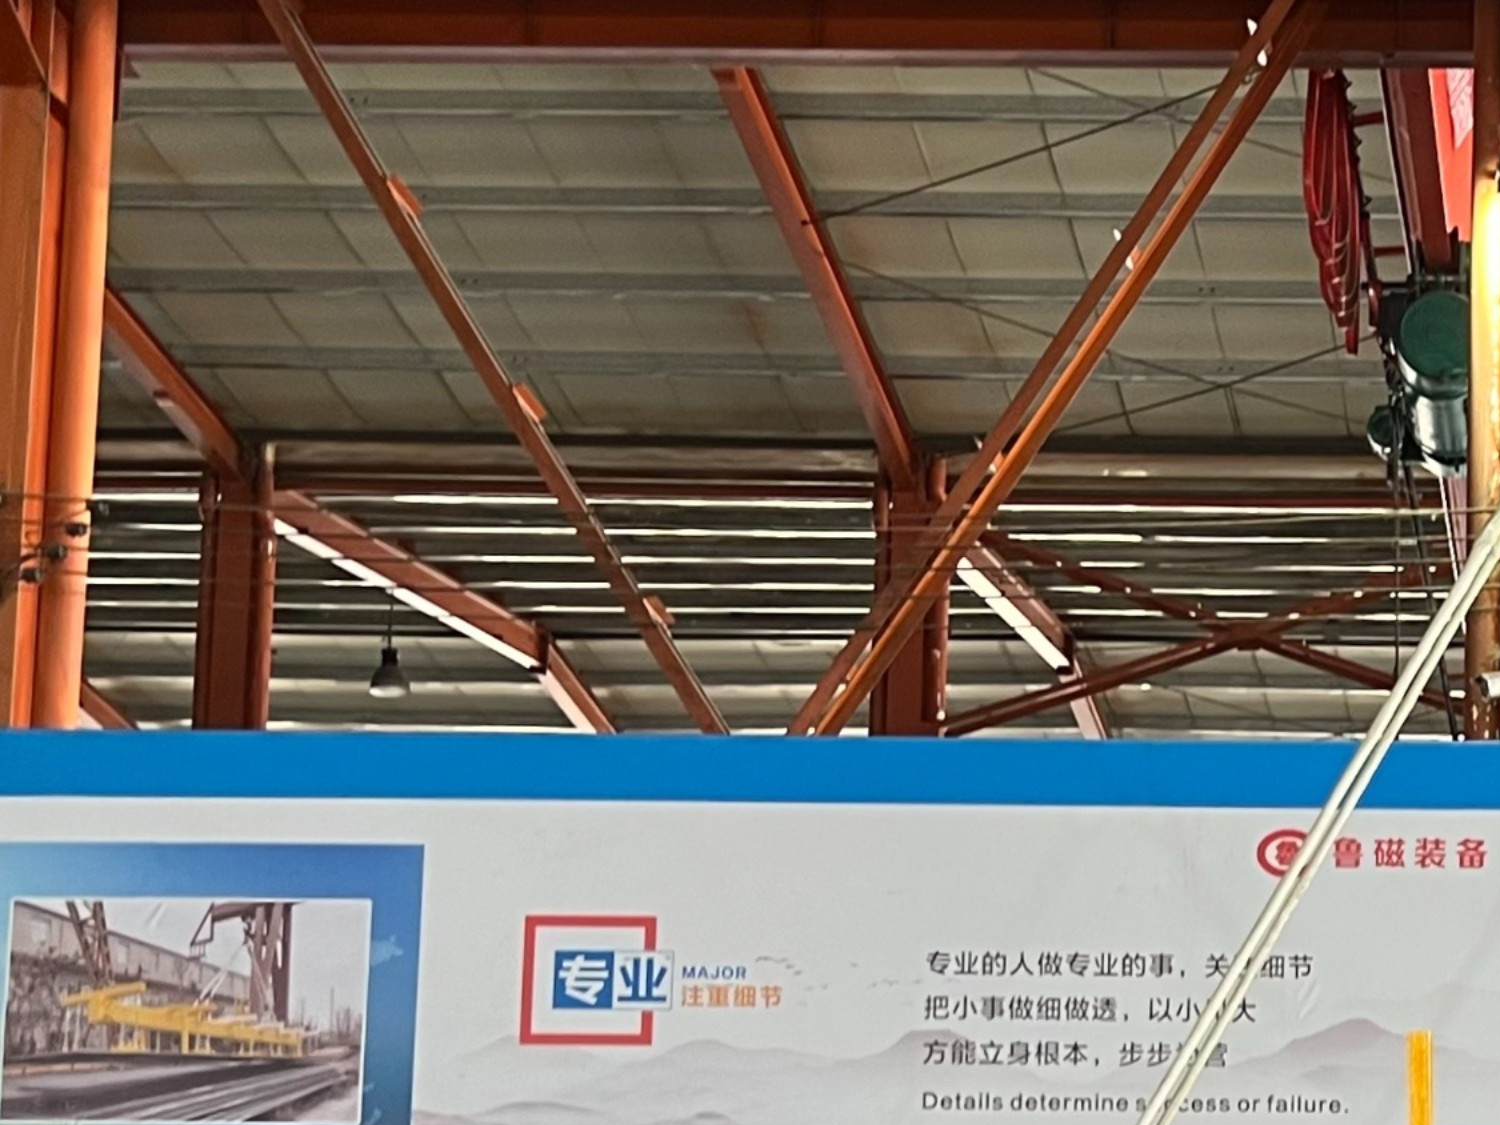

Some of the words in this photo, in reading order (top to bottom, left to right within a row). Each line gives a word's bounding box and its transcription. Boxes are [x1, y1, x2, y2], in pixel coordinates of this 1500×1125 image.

[1333, 837, 1487, 869] 鲁磁装备
[681, 965, 747, 980] MAJOR
[926, 951, 1314, 980] 专业的人做专业的事，关细节
[558, 953, 668, 1006] 专业
[681, 985, 783, 1009] 注重细节
[924, 996, 1257, 1023] 把小事做细做透，以小大
[922, 1091, 1004, 1112] Details
[1009, 1092, 1129, 1113] determine
[1135, 1097, 1231, 1113] sccess
[1237, 1098, 1261, 1113] or
[1267, 1093, 1350, 1114] failure.
